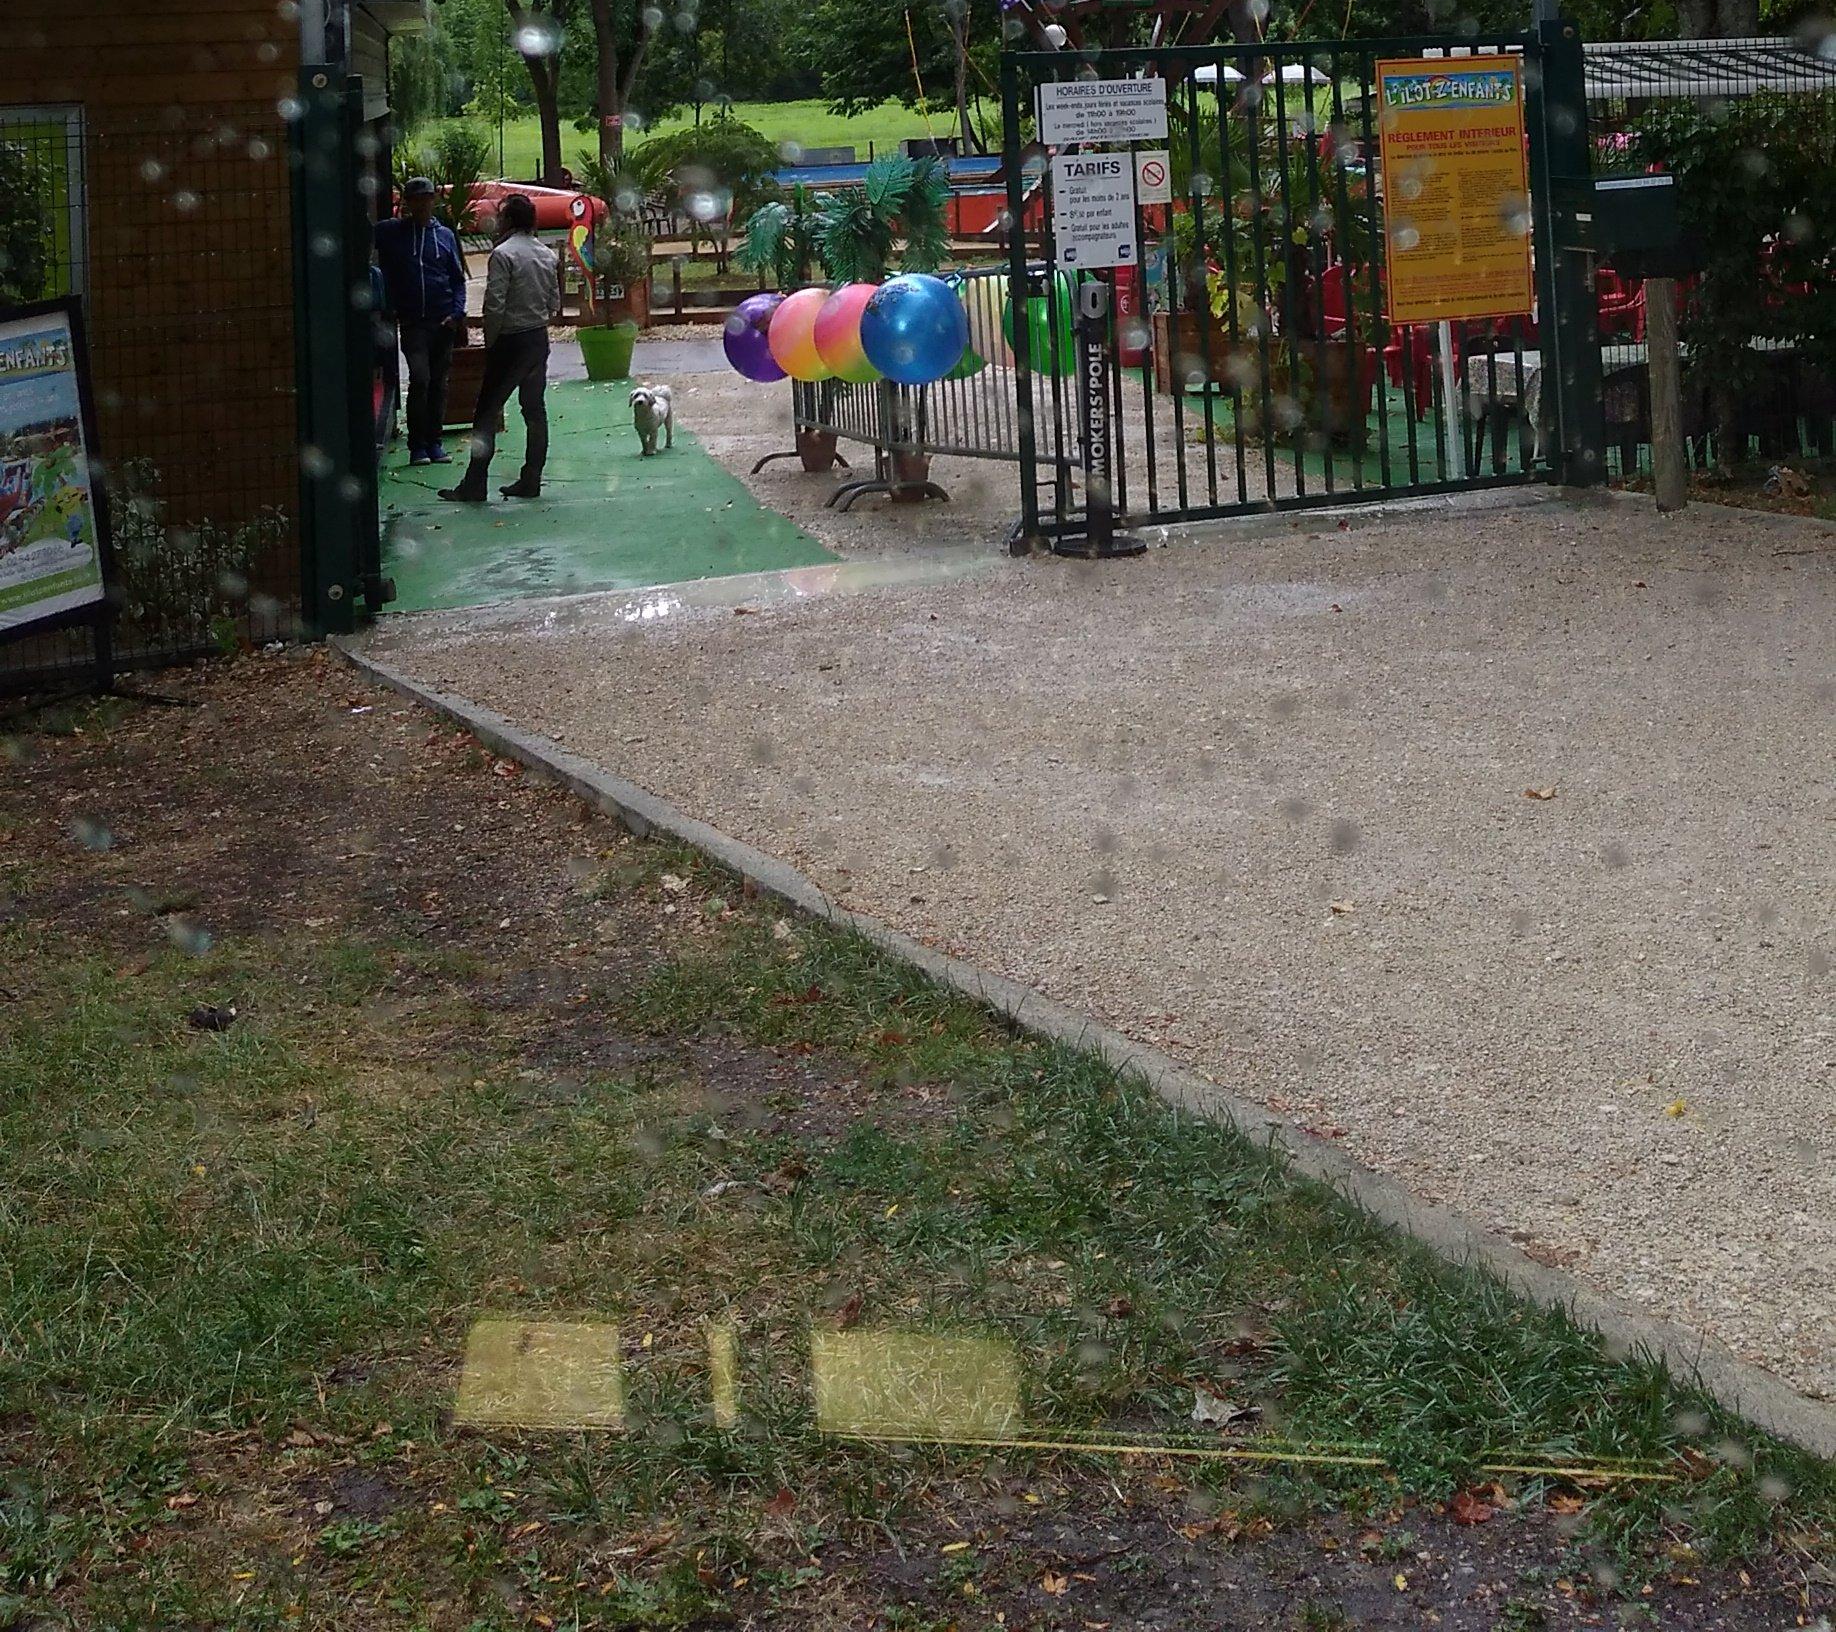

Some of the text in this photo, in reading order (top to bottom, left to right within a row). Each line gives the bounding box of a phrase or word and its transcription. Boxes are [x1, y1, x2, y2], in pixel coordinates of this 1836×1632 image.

[1056, 82, 1152, 96] HORAIRES D'OUVERTURE
[1064, 161, 1121, 176] TARIFS
